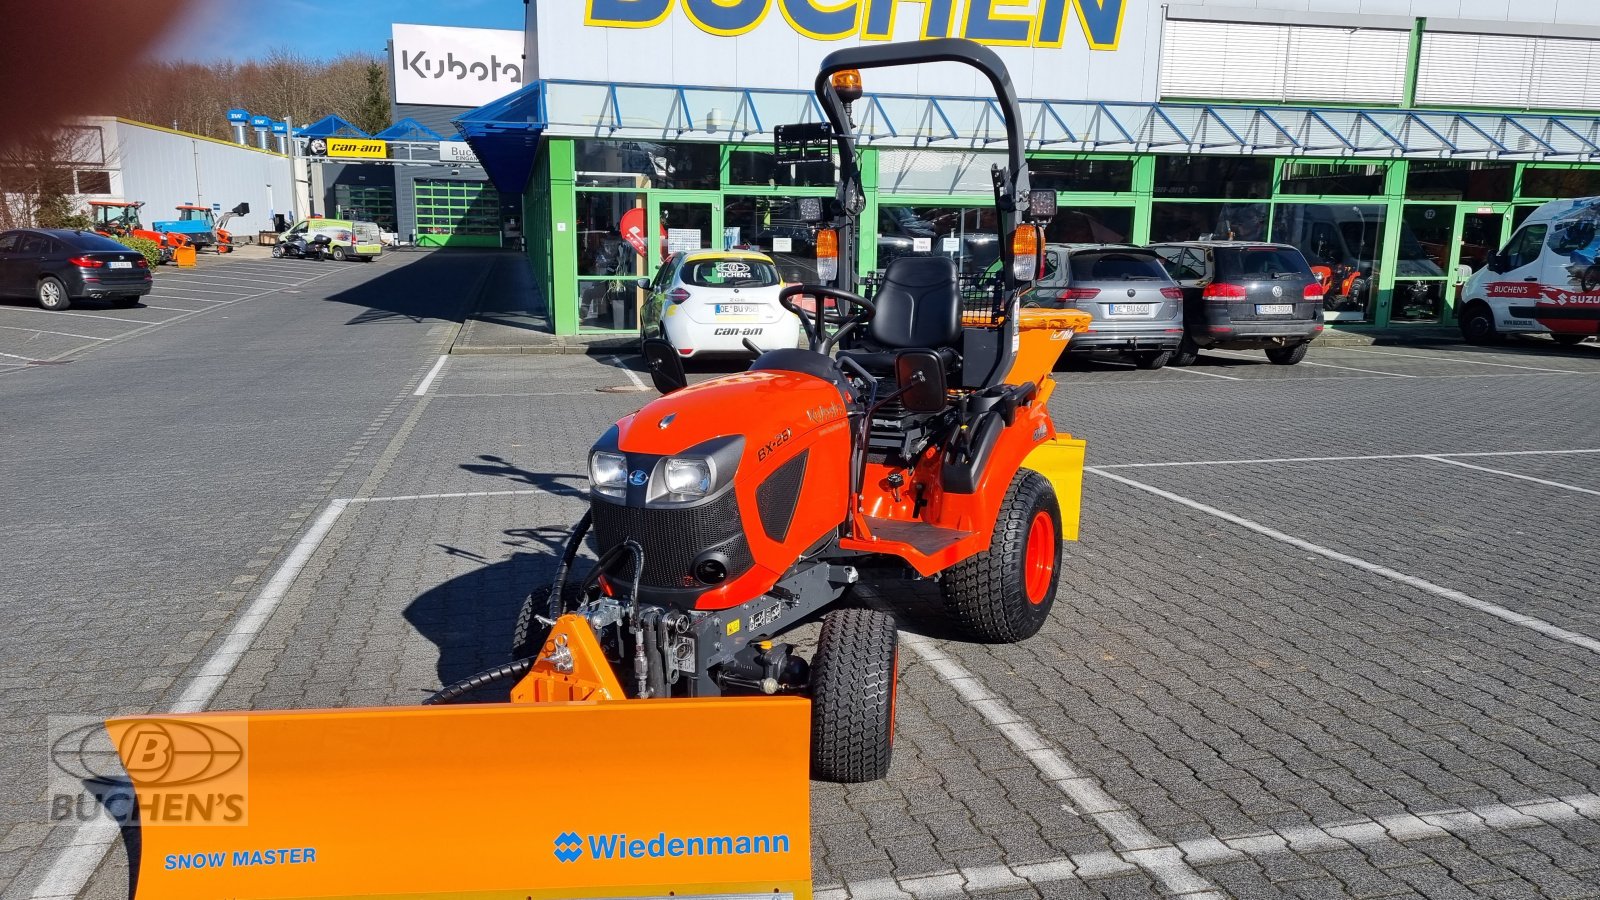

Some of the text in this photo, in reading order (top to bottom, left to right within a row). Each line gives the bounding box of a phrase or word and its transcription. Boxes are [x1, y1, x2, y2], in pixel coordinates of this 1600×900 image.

[402, 49, 522, 83] Kubota
[331, 143, 382, 153] can-am
[451, 146, 476, 156] Buc
[1493, 285, 1528, 294] BUCHEN'S
[714, 327, 764, 336] can-am
[588, 832, 790, 860] Wiedenmann
[163, 847, 317, 870] SNOW MASTER
